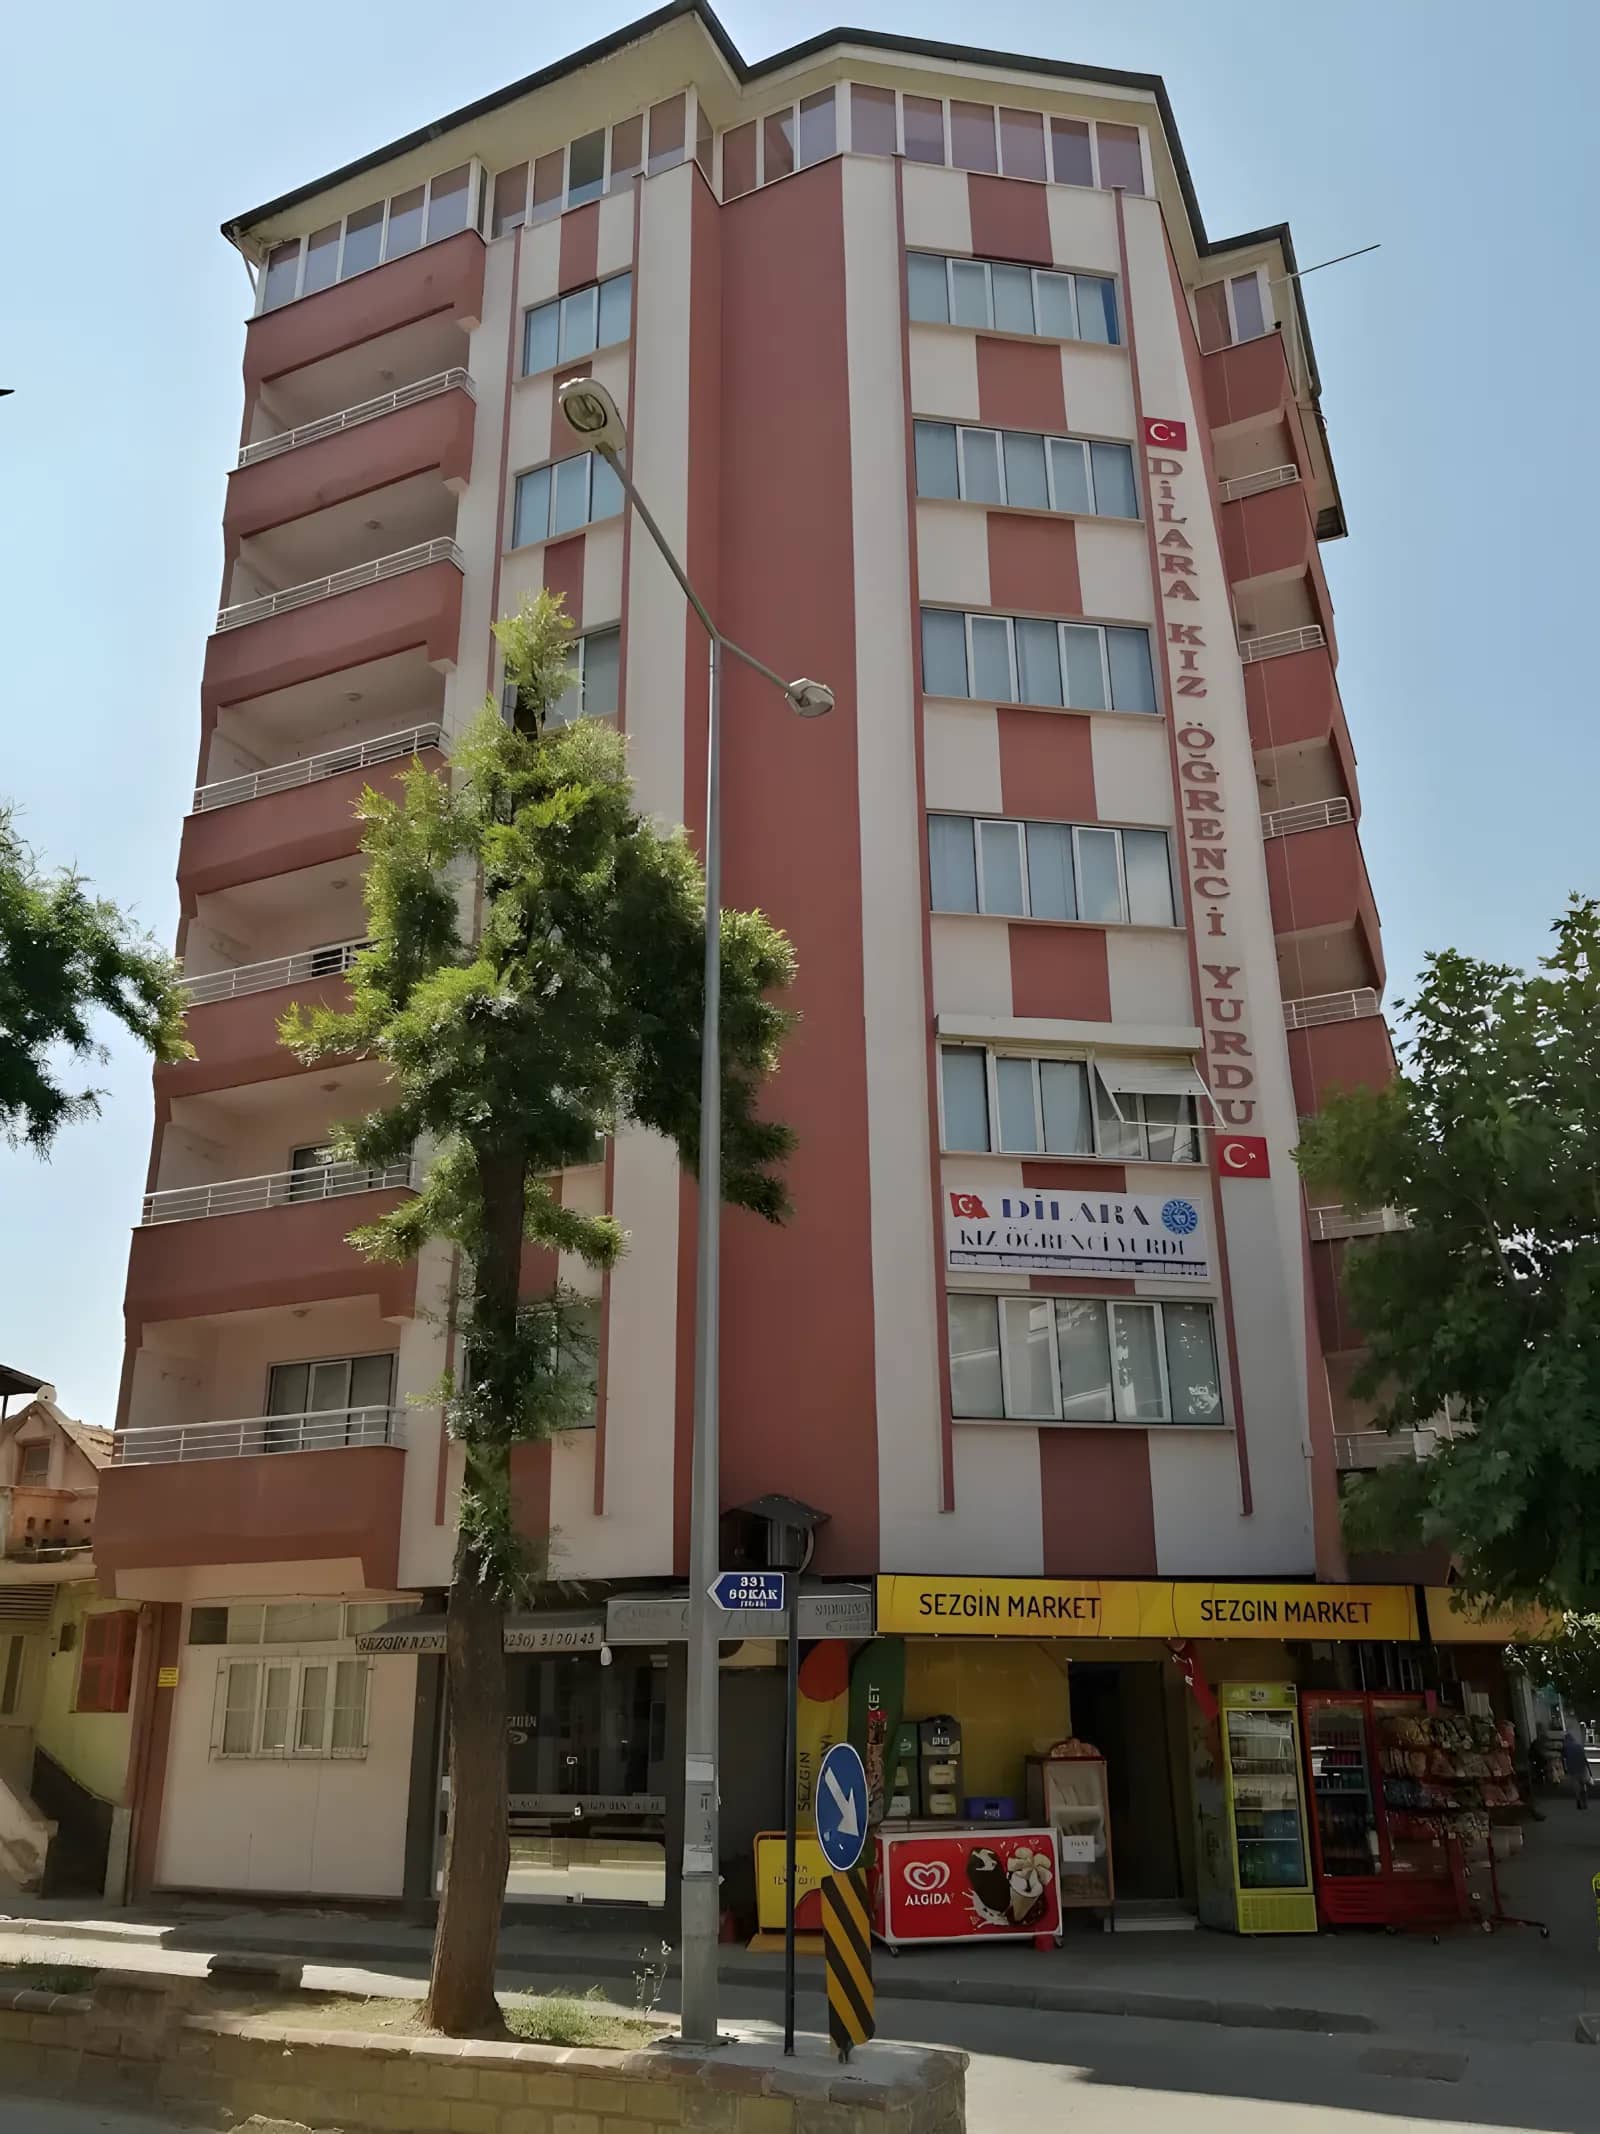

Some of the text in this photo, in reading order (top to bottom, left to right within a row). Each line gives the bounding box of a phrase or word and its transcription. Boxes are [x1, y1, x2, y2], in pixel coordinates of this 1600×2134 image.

[1167, 622, 1207, 698] KIZ
[1177, 721, 1231, 936] ÖĞRENCİ
[1202, 964, 1256, 1125] YURDU
[919, 1588, 1101, 1619] SEZGİN MARKET
[1285, 1600, 1373, 1624] MARKET
[905, 1893, 951, 1906] ALGIDA
